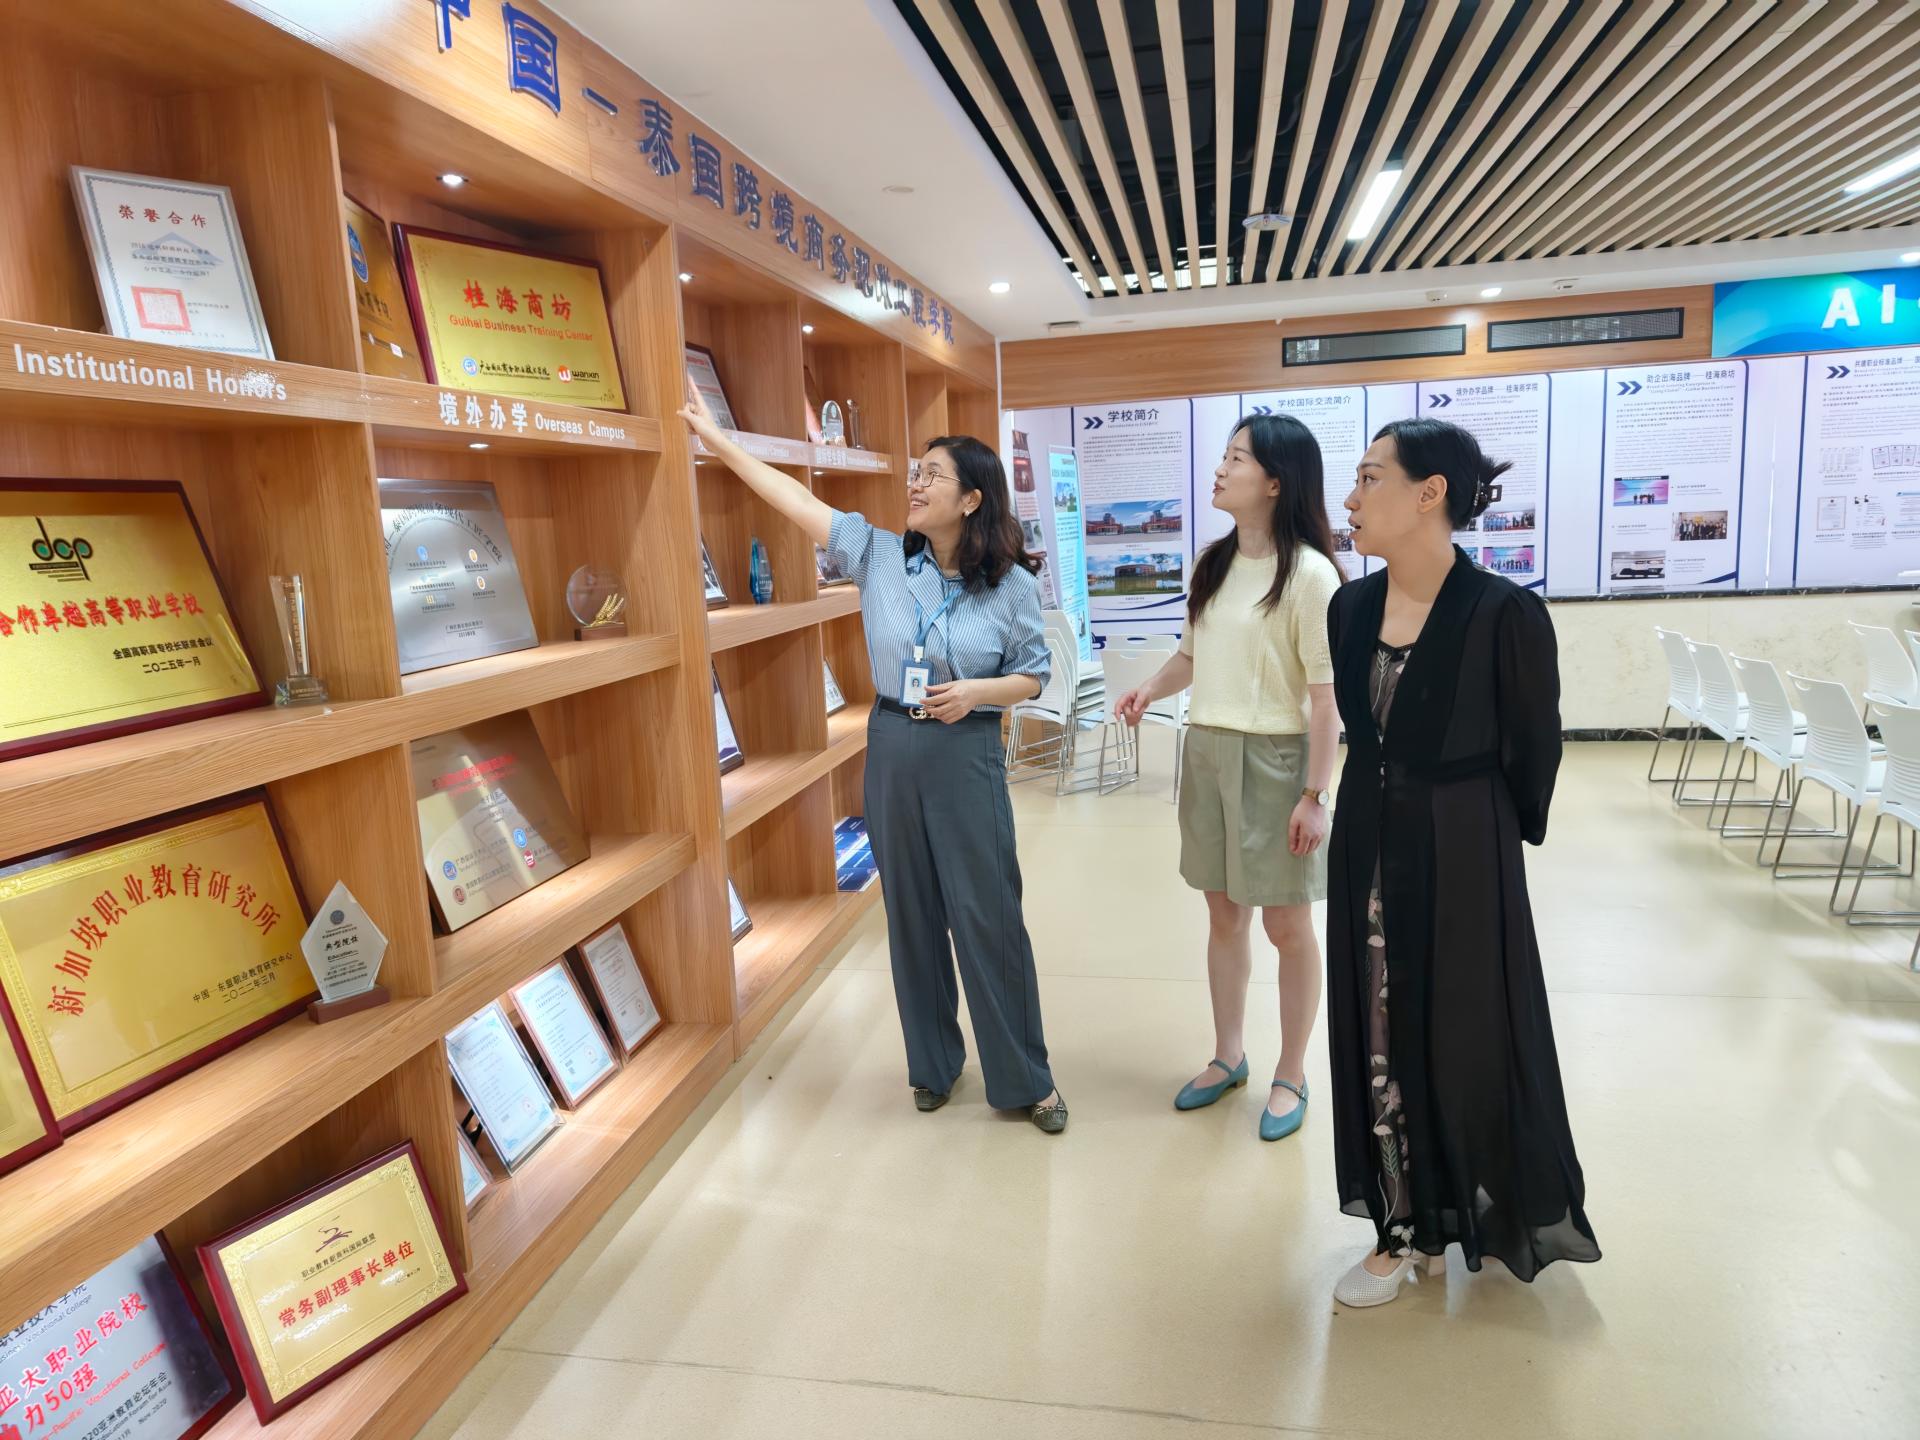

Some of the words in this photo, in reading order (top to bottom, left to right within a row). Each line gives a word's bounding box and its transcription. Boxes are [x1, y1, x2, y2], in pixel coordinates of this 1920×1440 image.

[463, 279, 572, 321] 桂海商坊
[450, 314, 483, 329] Guihai
[484, 319, 527, 334] Business
[528, 324, 564, 340] Training
[565, 329, 593, 342] Center
[13, 342, 195, 391] Institutional
[205, 367, 287, 401] Honors
[438, 391, 529, 433] 境外办学
[534, 412, 584, 434] Overseas
[588, 420, 626, 441] Campus
[1107, 408, 1159, 422] 学校简介
[48, 863, 281, 1017] 新加坡职业教育研究所
[278, 1240, 415, 1328] 常务副理事长单位
